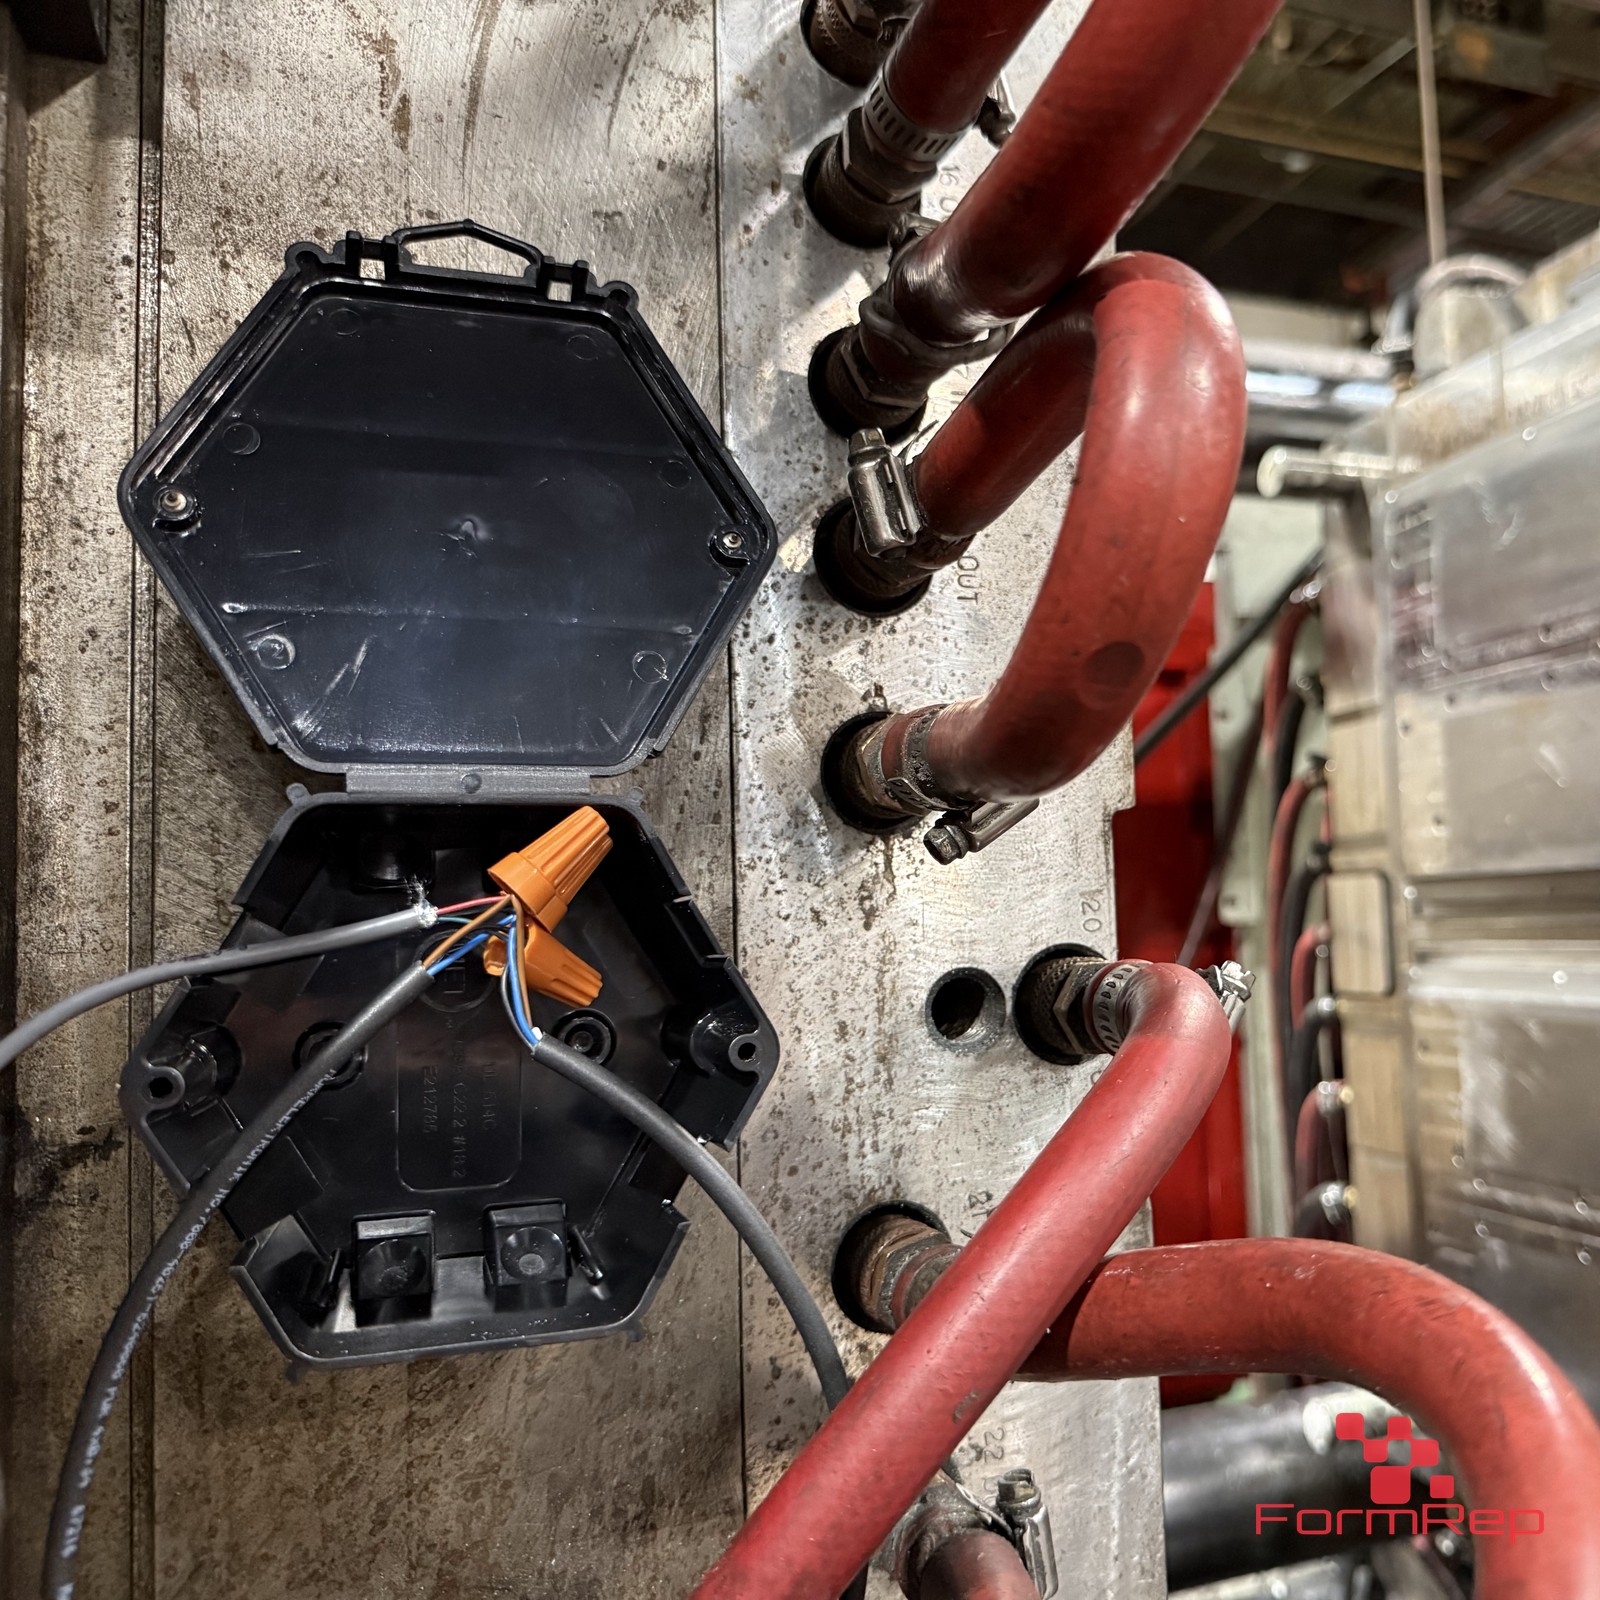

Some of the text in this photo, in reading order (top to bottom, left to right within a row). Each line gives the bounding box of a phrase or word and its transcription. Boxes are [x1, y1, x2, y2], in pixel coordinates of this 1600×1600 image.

[939, 165, 960, 186] 16
[957, 556, 979, 605] OUT
[983, 1427, 1005, 1463] 22
